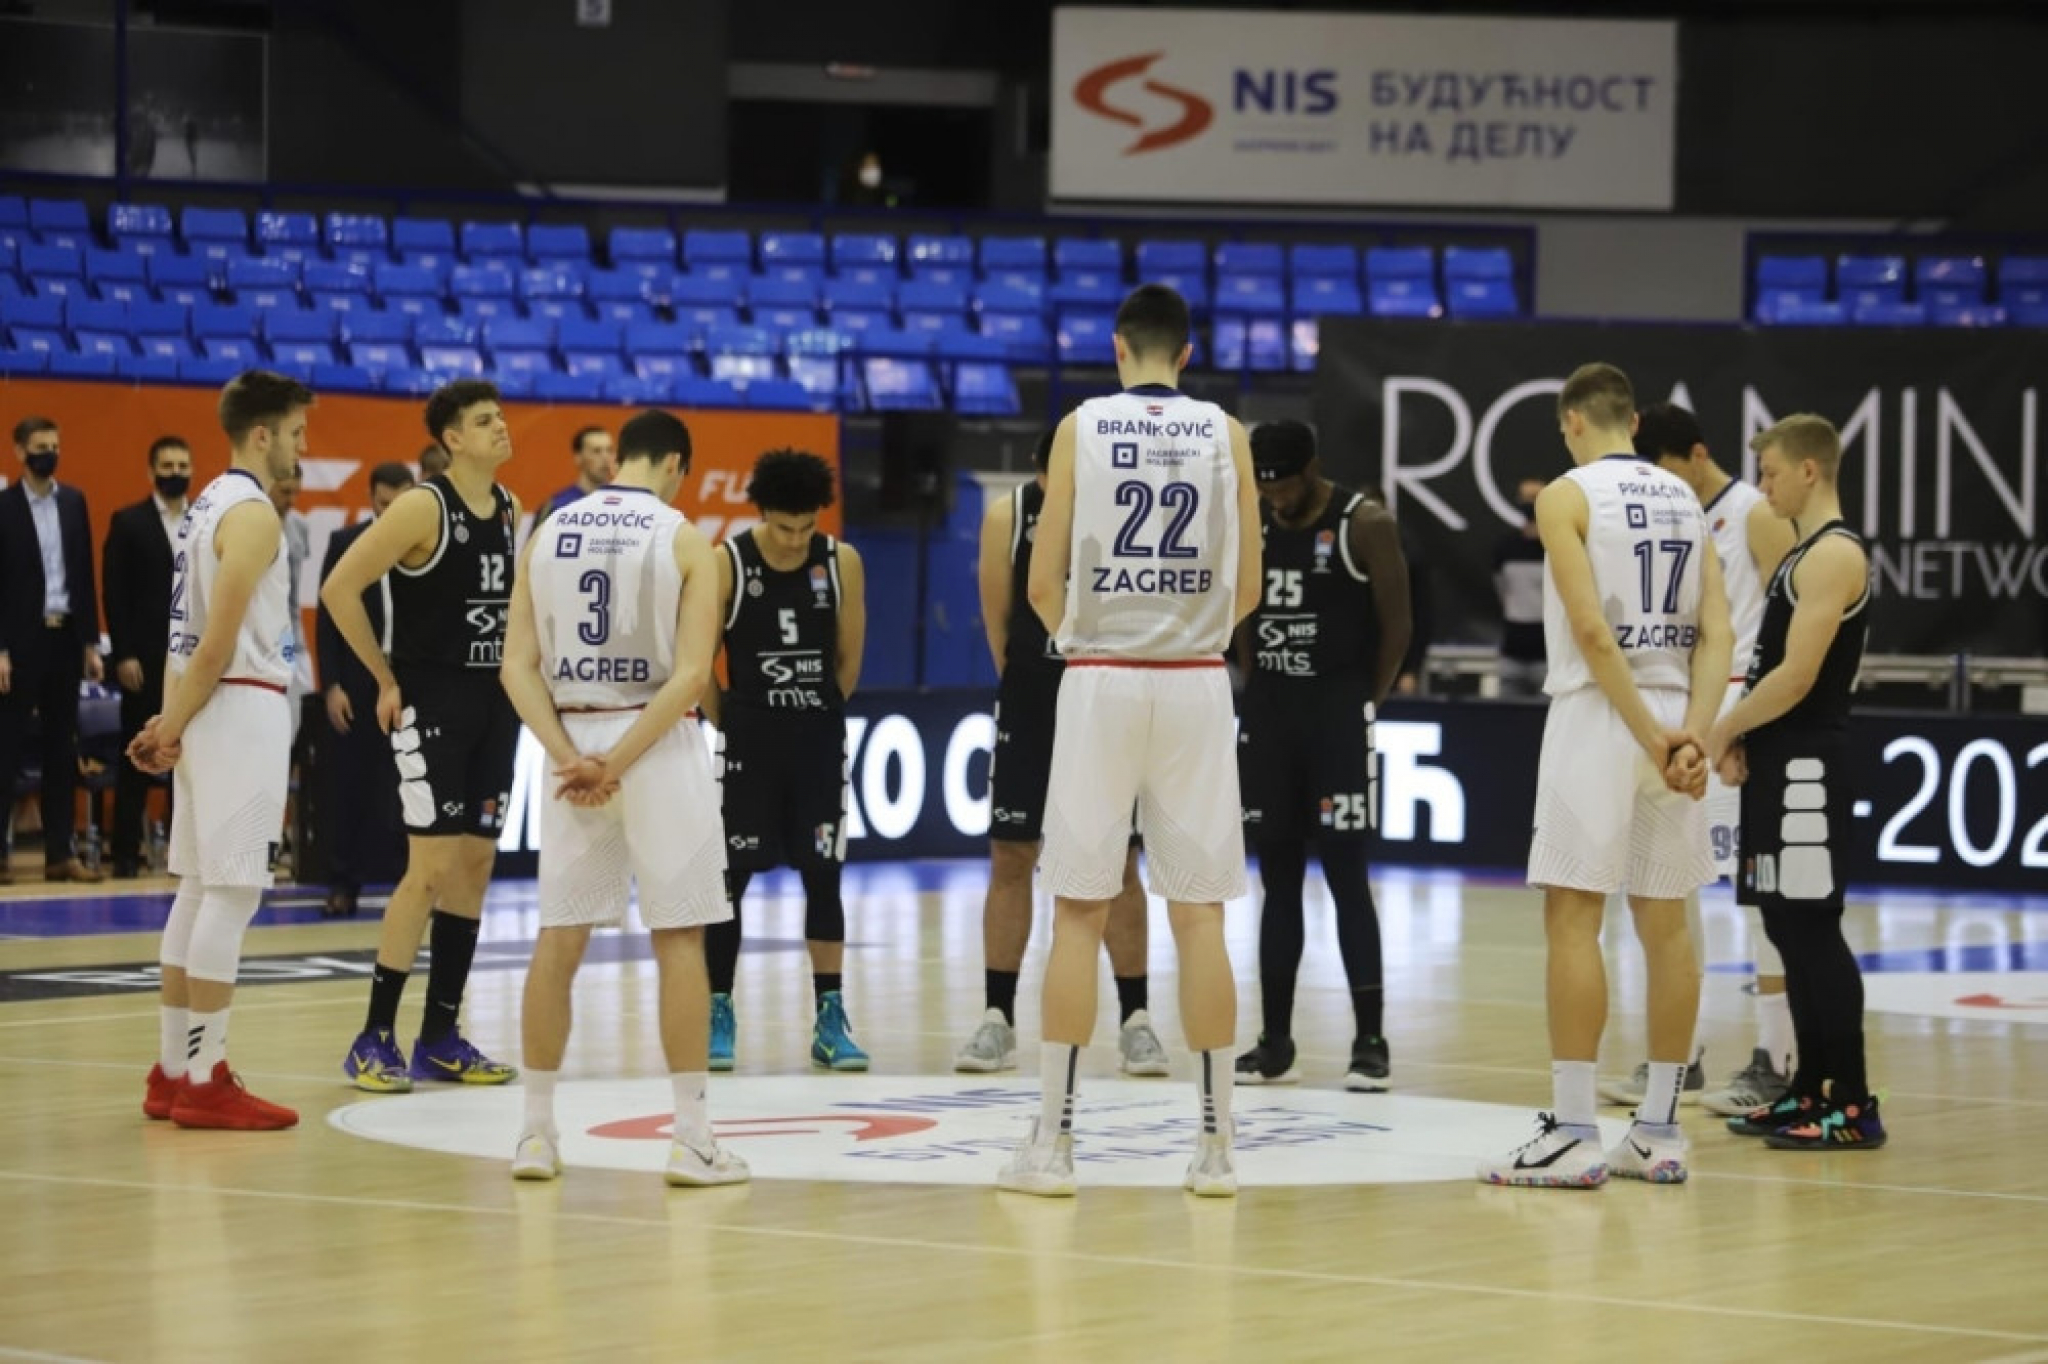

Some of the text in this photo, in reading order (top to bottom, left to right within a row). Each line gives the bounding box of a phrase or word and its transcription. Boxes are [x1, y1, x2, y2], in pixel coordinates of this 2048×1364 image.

[1233, 69, 1339, 115] NIS
[1369, 70, 1658, 114] БУДУЋНОСТ
[1368, 120, 1577, 161] НА ДЕЛУ
[1097, 418, 1213, 438] BRANKOVIĆ
[1380, 375, 2037, 540] ROMIN
[556, 510, 654, 529] RADOVČIĆ
[1112, 479, 1199, 559] 22
[480, 553, 505, 592] 32
[1092, 567, 1213, 594] ZAGREB
[1266, 569, 1303, 607] 25
[1634, 540, 1694, 614] 17
[577, 569, 611, 646] 3
[778, 608, 799, 645] 5
[1287, 622, 1318, 637] NIS
[470, 636, 504, 662] mt
[795, 659, 822, 672] NIS
[1257, 647, 1312, 672] mts
[1333, 793, 1366, 830] 25
